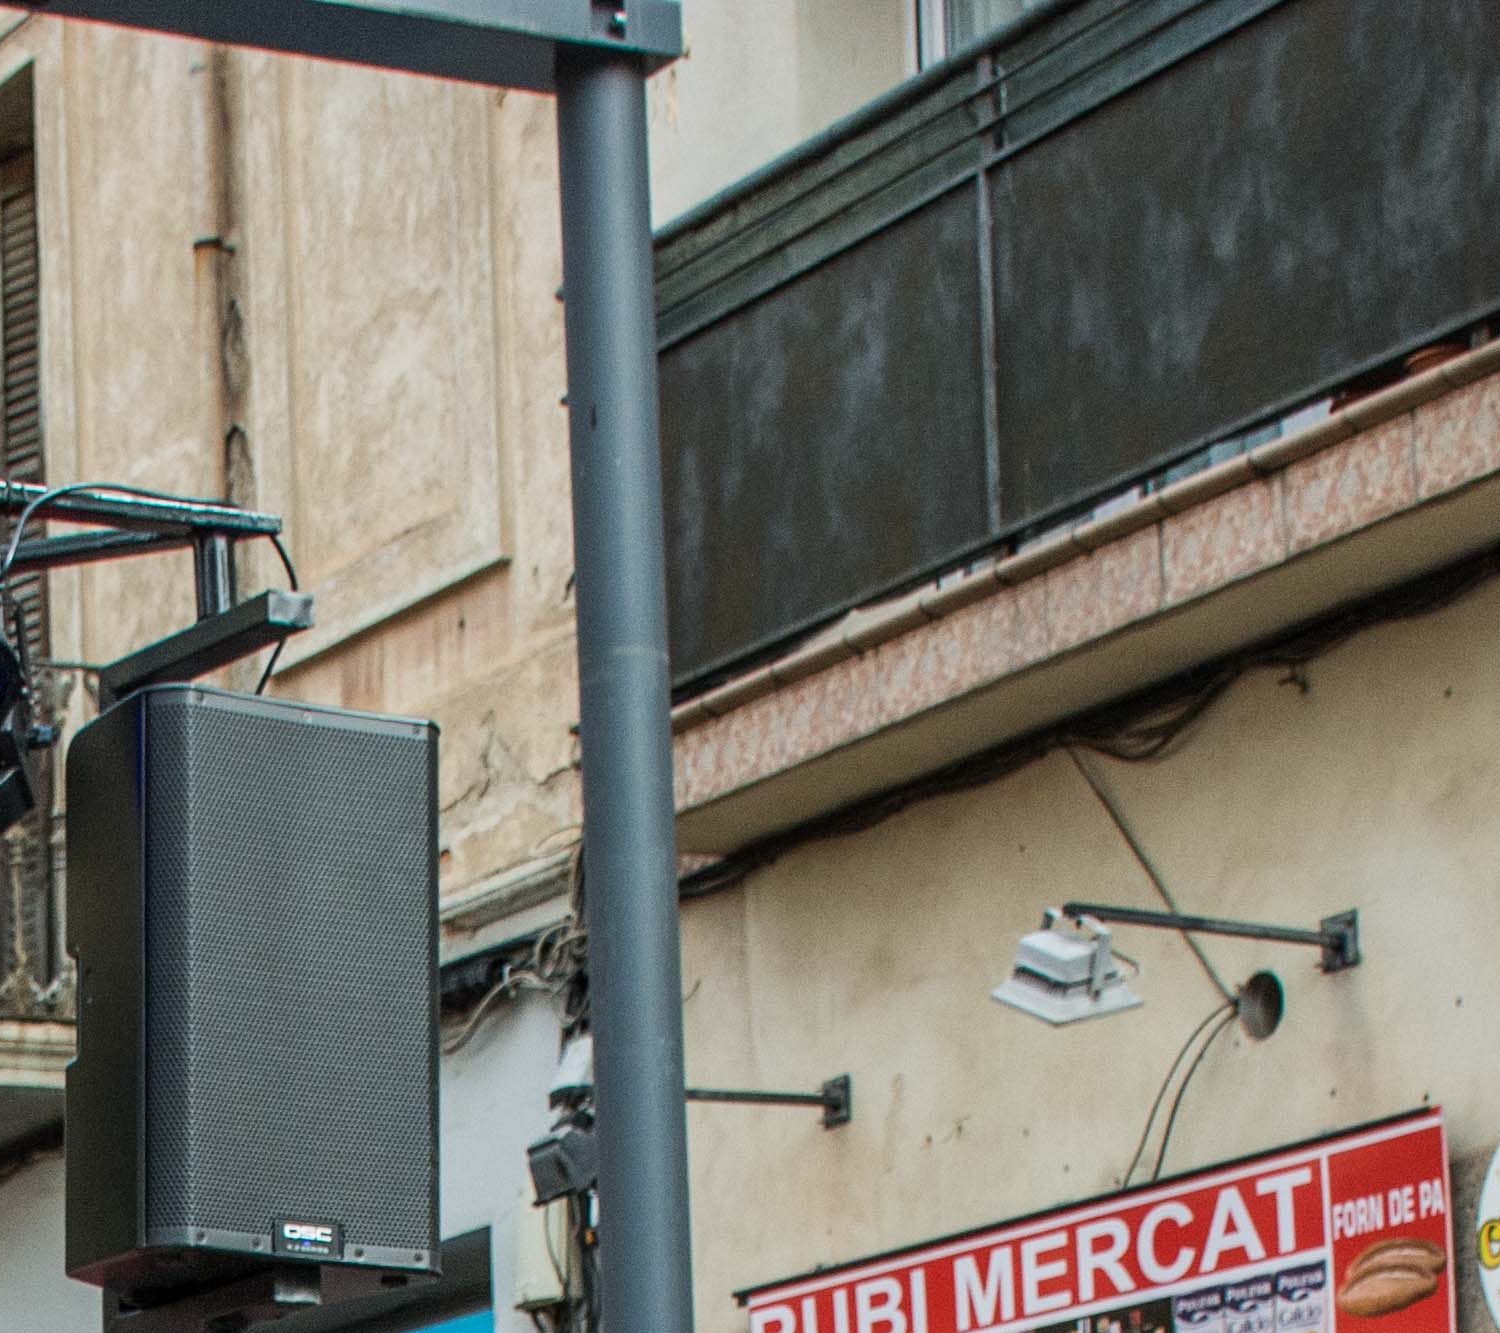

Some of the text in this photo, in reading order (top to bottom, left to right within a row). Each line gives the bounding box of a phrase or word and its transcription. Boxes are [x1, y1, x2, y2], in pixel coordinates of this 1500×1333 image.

[283, 1223, 333, 1242] QSC
[1332, 1178, 1446, 1240] FORN DE PA
[953, 1167, 1312, 1333] MERCAT
